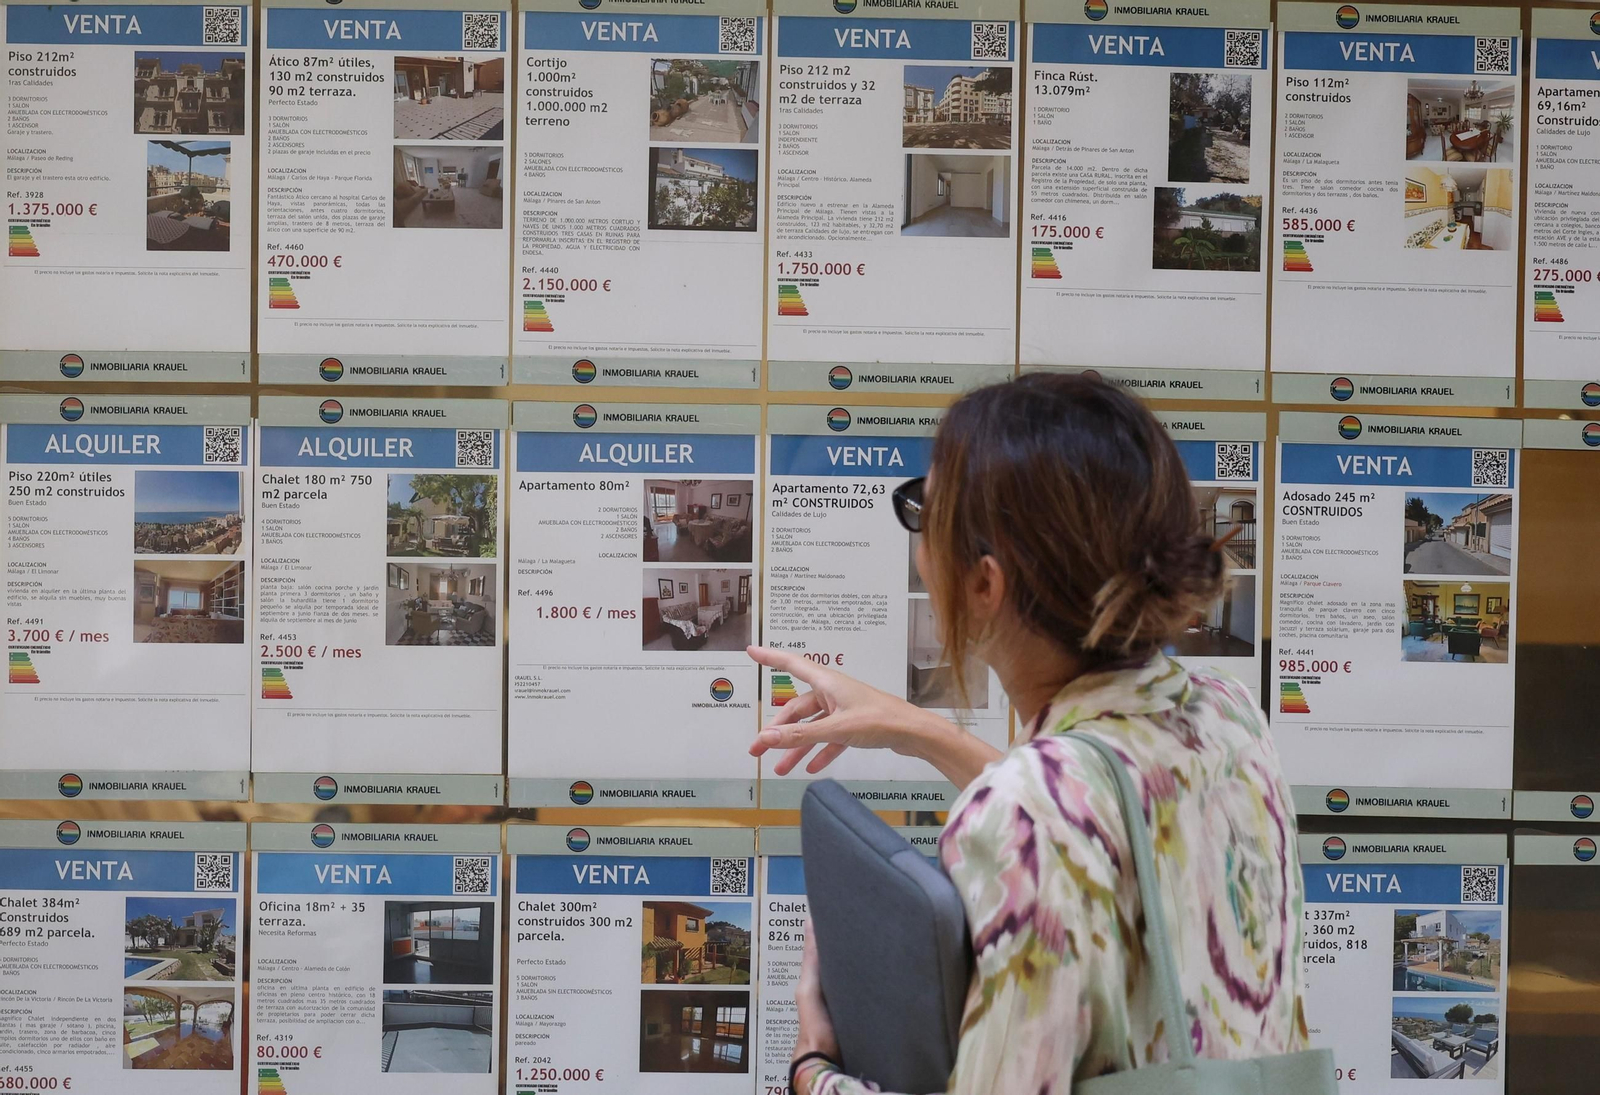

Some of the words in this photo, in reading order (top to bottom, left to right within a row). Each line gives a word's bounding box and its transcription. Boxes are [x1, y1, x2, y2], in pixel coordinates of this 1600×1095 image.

[64, 15, 142, 34] VENTA
[1366, 15, 1423, 23] INMOBILIARIA
[1427, 16, 1460, 24] KRAUEL
[324, 20, 401, 39] VENTA
[581, 21, 658, 42] VENTA
[834, 29, 911, 48] VENTA
[1088, 35, 1164, 56] VENTA
[9, 51, 32, 61] Piso
[1340, 42, 1415, 62] VENTA
[269, 54, 299, 66] Ático
[339, 57, 374, 69] útiles,
[527, 57, 567, 70] Cortijo
[8, 67, 76, 76] construidos
[780, 65, 803, 74] Piso
[808, 65, 828, 75] 212
[833, 66, 850, 75] m2
[1035, 70, 1065, 80] Finca
[1070, 71, 1097, 82] Rúst.
[1287, 77, 1309, 87] Piso
[526, 88, 593, 98] construidos
[1286, 93, 1351, 103] construidos
[527, 101, 586, 112] 1.000.000
[590, 103, 607, 112] m2
[526, 116, 570, 126] terreno
[9, 203, 83, 215] 1.375.000
[89, 204, 97, 216] €
[1283, 218, 1341, 231] 585.000
[1347, 220, 1355, 232] €
[1032, 225, 1090, 238] 175.000
[1096, 227, 1104, 238] €
[268, 255, 328, 267] 470.000
[334, 256, 342, 268] €
[778, 262, 851, 275] 1.750.000
[857, 264, 865, 275] €
[523, 278, 597, 291] 2.150.000
[603, 280, 611, 292] €
[154, 363, 188, 371] KRAUEL
[91, 406, 149, 414] INMOBILIARIA
[1368, 426, 1425, 434] INMOBILIARIA
[1429, 428, 1462, 436] KRAUEL
[45, 434, 161, 457] ALQUILER
[298, 437, 413, 460] ALQUILER
[579, 443, 694, 466] ALQUILER
[827, 446, 904, 466] VENTA
[1337, 455, 1412, 475] VENTA
[9, 471, 32, 481] Piso
[80, 472, 111, 482] útiles
[262, 474, 300, 484] Chalet
[305, 475, 325, 484] 180
[351, 475, 372, 485] 750
[9, 486, 30, 496] 250
[35, 486, 52, 496] m2
[57, 487, 124, 496] construidos
[519, 480, 595, 492] Apartamento
[772, 483, 848, 495] Apartamento
[853, 484, 885, 496] 72,63
[262, 489, 280, 498] m2
[284, 490, 327, 501] parcela
[1283, 491, 1330, 501] Adosado
[1335, 492, 1355, 502] 245
[793, 498, 873, 508] CONSTRUIDOS
[1283, 506, 1362, 517] COSNTRUIDOS
[537, 606, 577, 618] 1.800
[583, 607, 591, 618] €
[596, 607, 602, 618] /
[608, 610, 636, 619] mes
[8, 630, 50, 642] 3.700
[55, 630, 64, 642] €
[69, 630, 75, 642] /
[81, 633, 109, 642] mes
[261, 645, 302, 657] 2.500
[308, 646, 316, 657] €
[322, 646, 327, 657] /
[333, 649, 361, 658] mes
[1279, 660, 1338, 672] 985.000
[1343, 661, 1351, 673] €
[597, 837, 655, 845] INMOBILIARIA
[55, 860, 133, 880] VENTA
[314, 864, 392, 884] VENTA
[573, 865, 650, 884] VENTA
[1326, 874, 1401, 893] VENTA
[260, 901, 300, 911] Oficina
[352, 902, 365, 912] 35
[518, 901, 555, 911] Chalet
[259, 917, 305, 926] terraza.
[518, 917, 585, 926] construidos
[590, 917, 610, 926] 300
[615, 917, 632, 927] m2
[1313, 925, 1333, 934] 360
[1338, 925, 1354, 935] m2
[518, 931, 564, 942] parcela.
[257, 1046, 308, 1058] 80.000
[314, 1046, 322, 1058] €
[517, 1068, 590, 1081] 1.250.000
[596, 1069, 604, 1081] €
